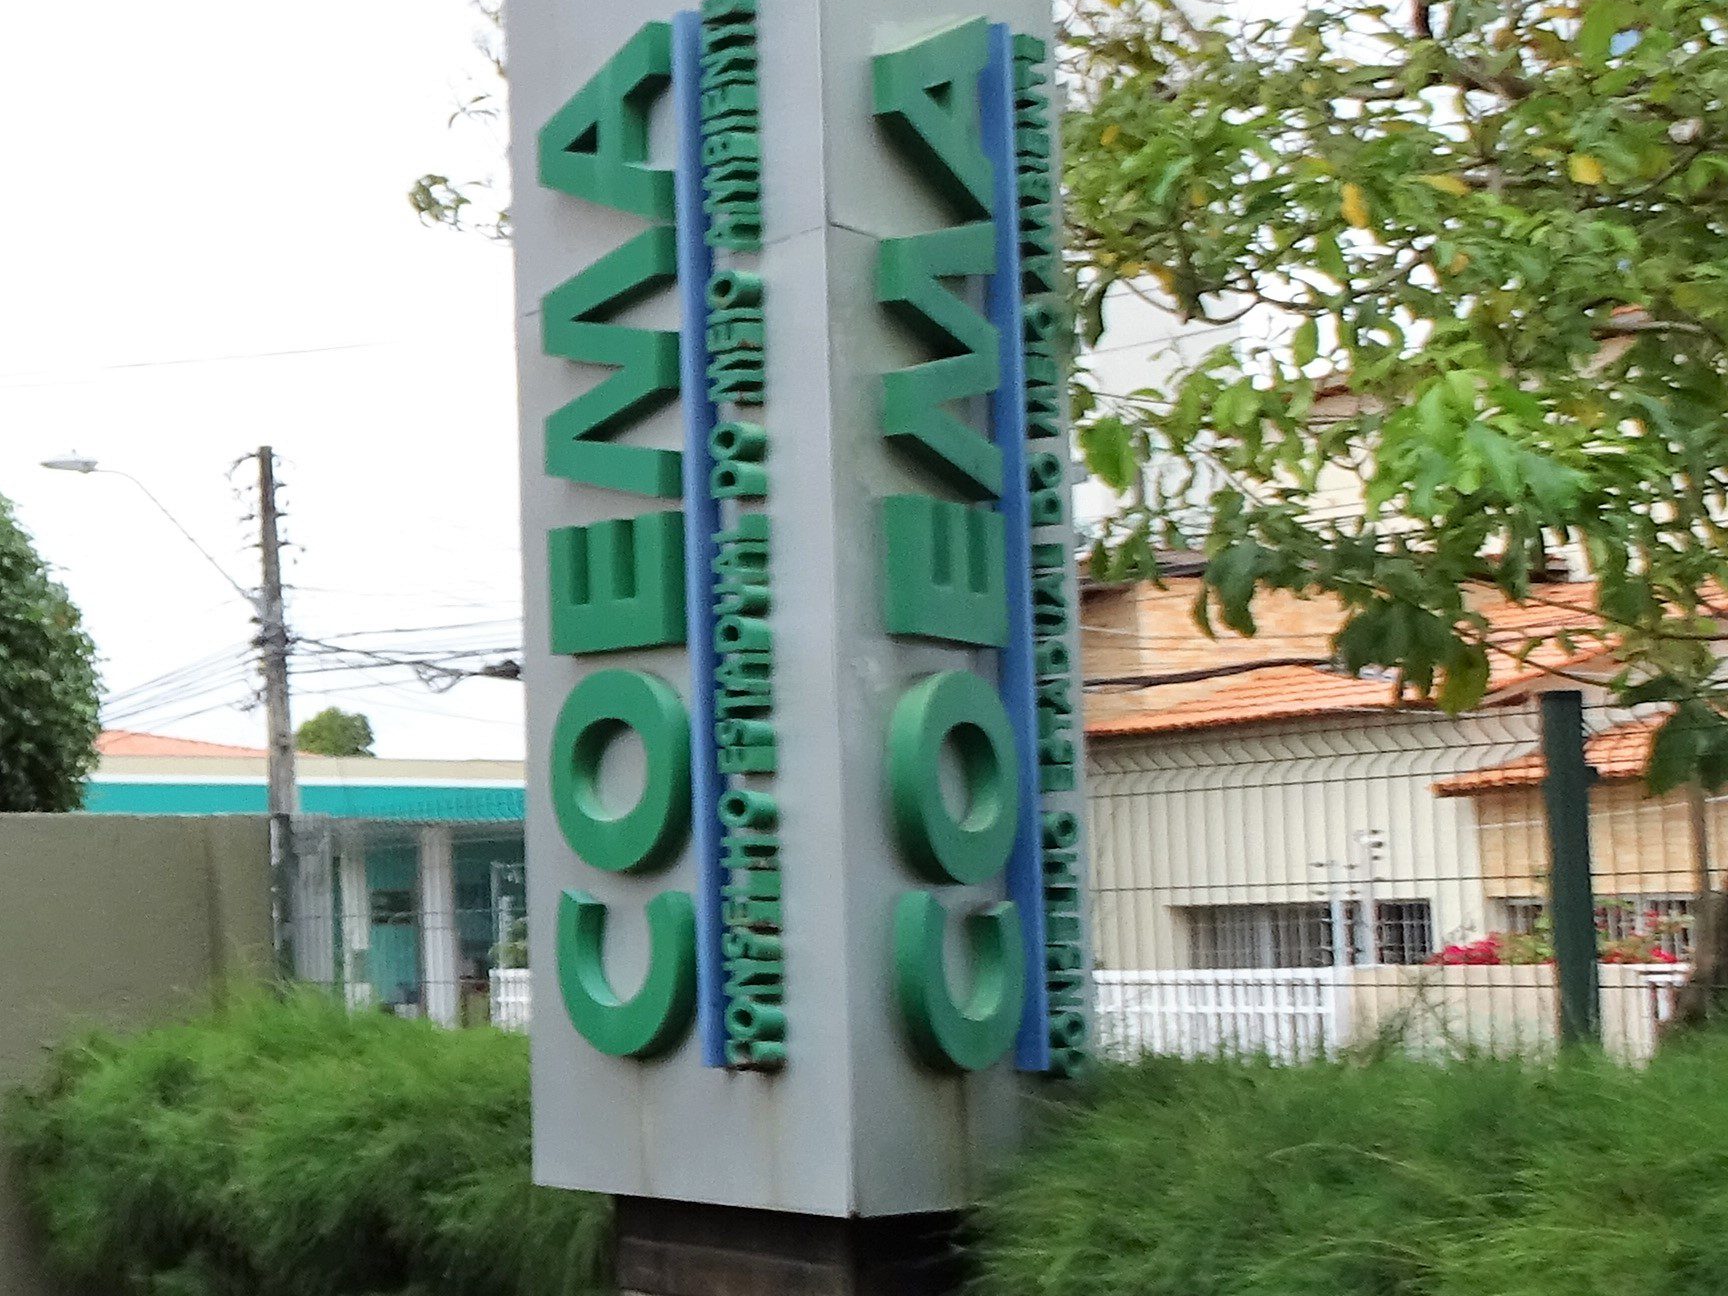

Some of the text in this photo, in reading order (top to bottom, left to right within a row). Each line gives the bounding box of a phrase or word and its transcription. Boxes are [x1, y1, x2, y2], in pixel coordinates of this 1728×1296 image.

[706, 270, 764, 405] MEIO
[709, 421, 770, 502] DO
[537, 19, 697, 1058] COEMA
[712, 513, 777, 774] ESTADUAL
[872, 16, 1026, 1071] COEMA
[1012, 34, 1086, 1079] CONSELHO ESTADUAL DO MEIO AMBIENTE
[720, 790, 788, 1066] CONSELHO
